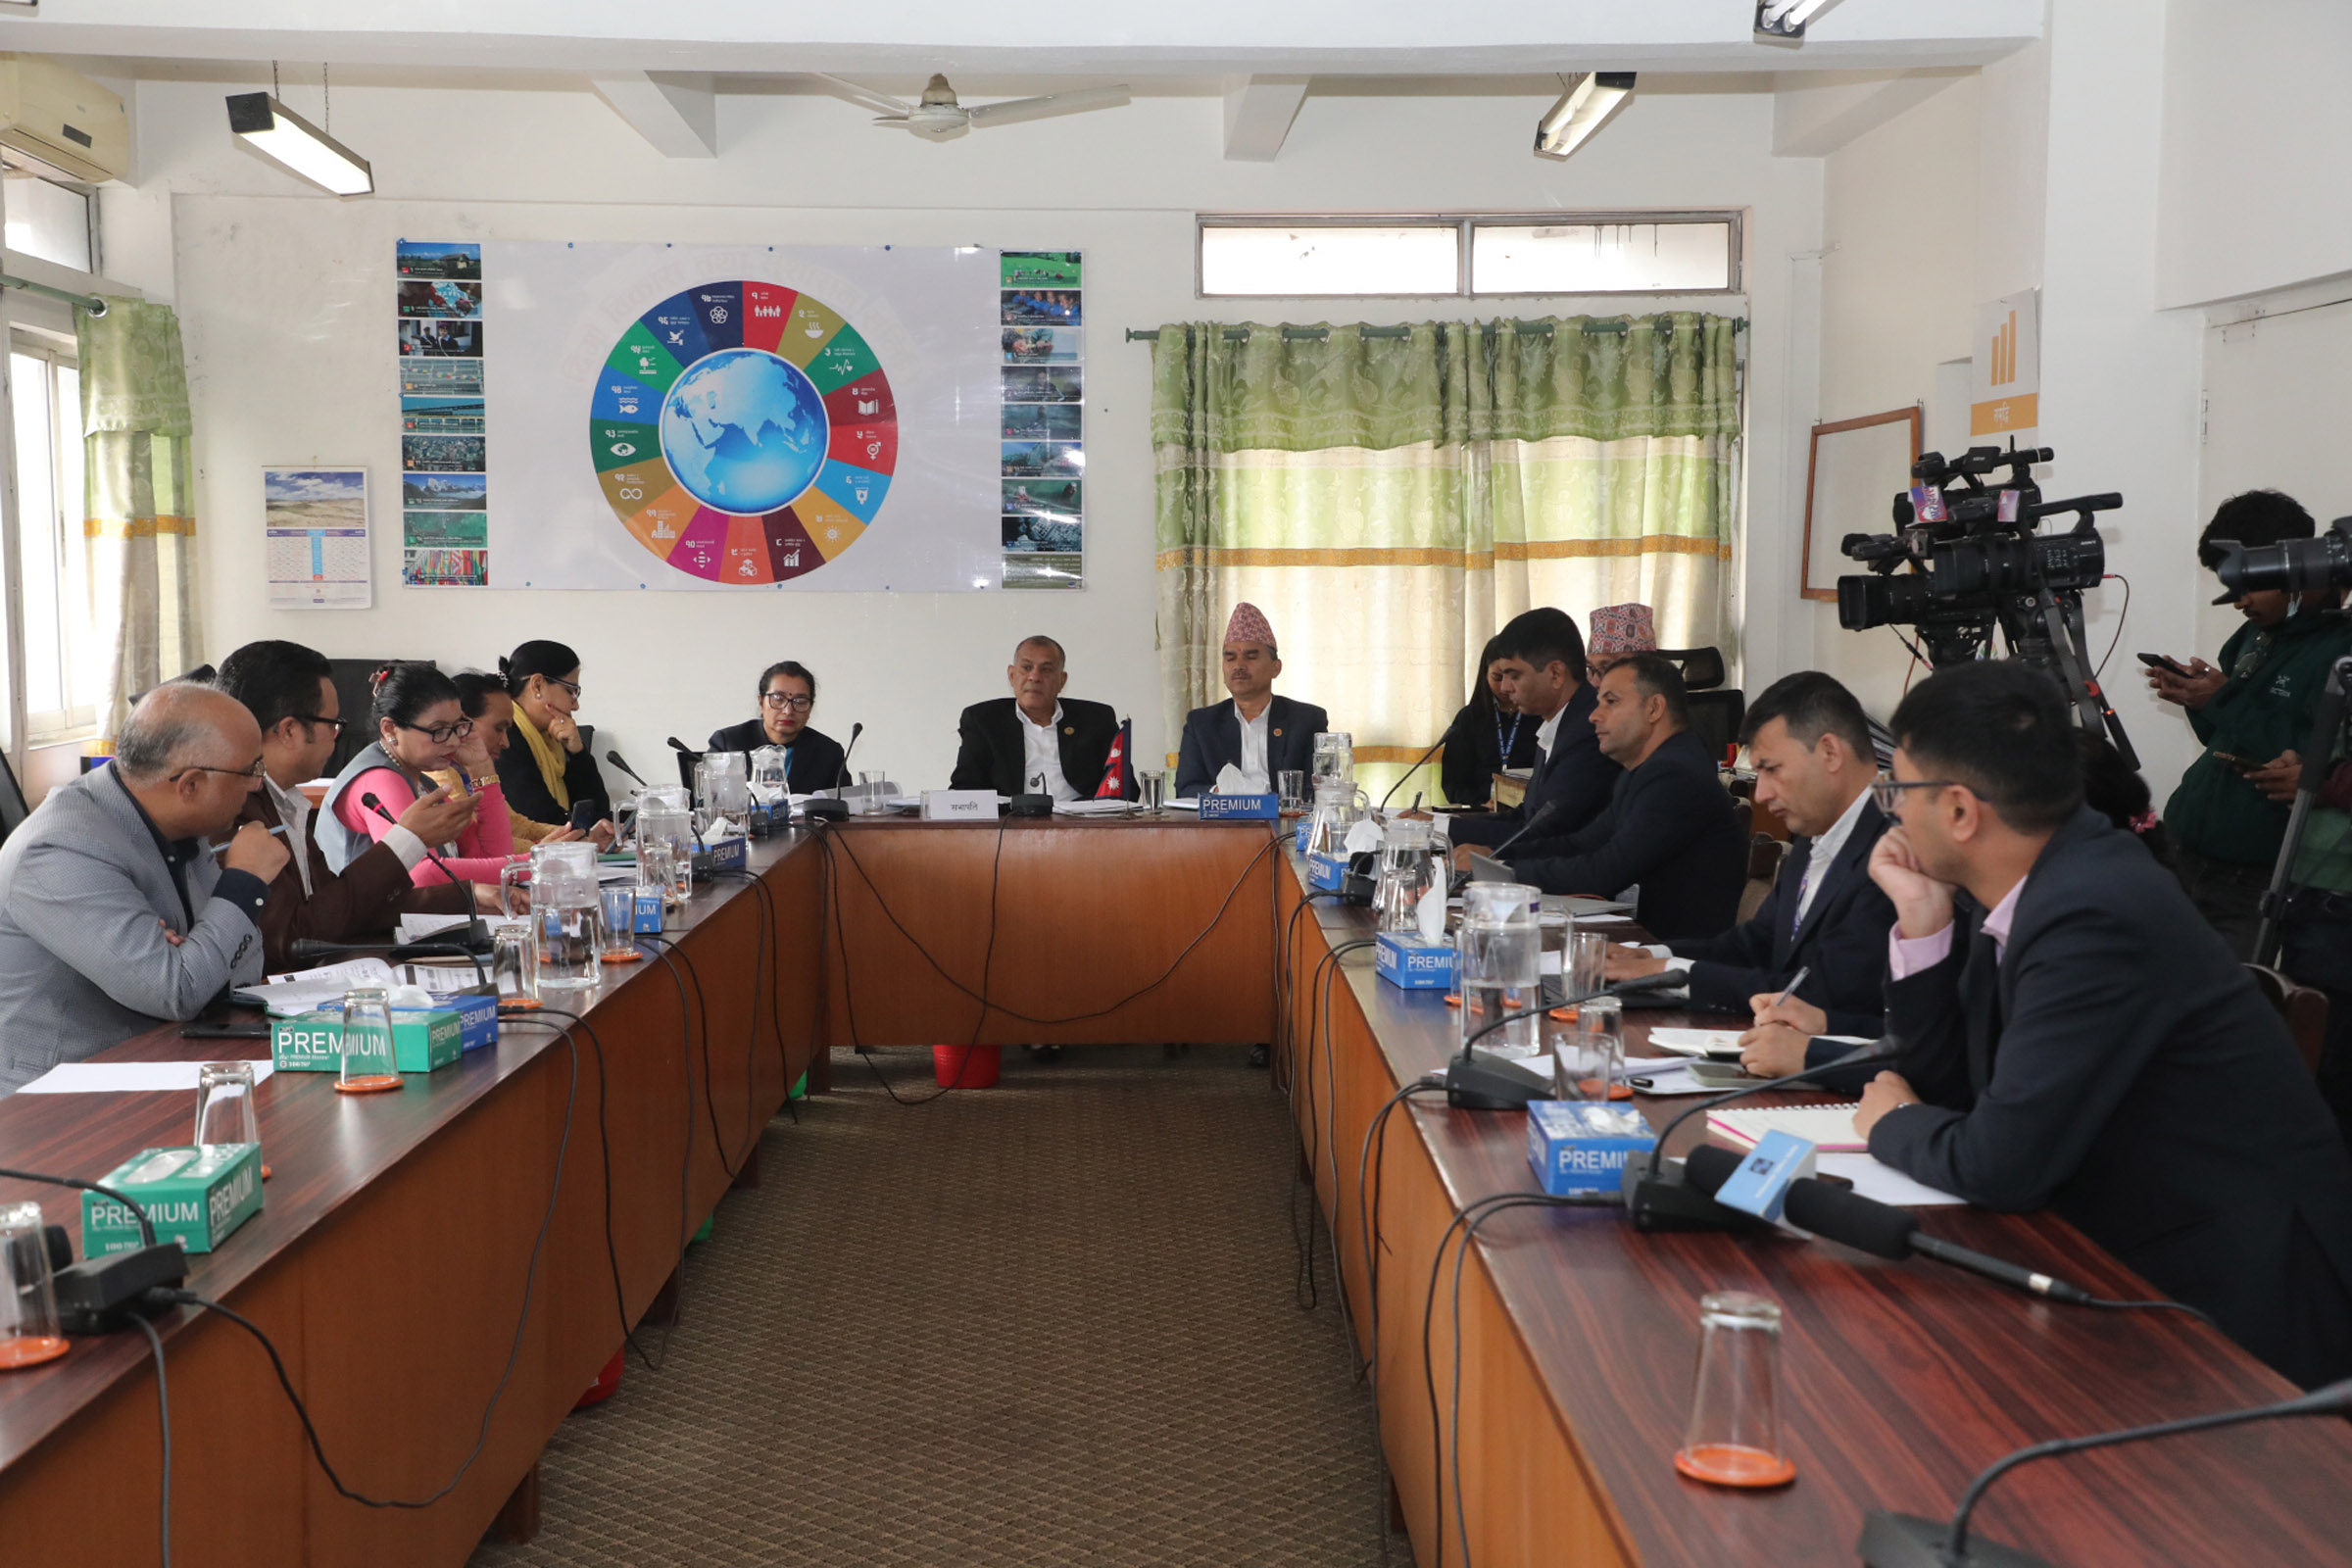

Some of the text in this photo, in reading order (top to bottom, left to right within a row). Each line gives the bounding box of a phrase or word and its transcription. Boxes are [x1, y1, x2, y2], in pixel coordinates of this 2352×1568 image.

[951, 801, 978, 811] सभापति
[1202, 799, 1261, 810] PREMIUM
[713, 844, 740, 862] PREMIUM
[1408, 956, 1453, 968] PREMI
[431, 1020, 461, 1046] PREMIUM
[278, 1032, 386, 1056] PREMIUM
[1559, 1151, 1628, 1169] PREMI
[210, 1166, 253, 1225] PREMIUM
[91, 1202, 199, 1226] PREMIUM
